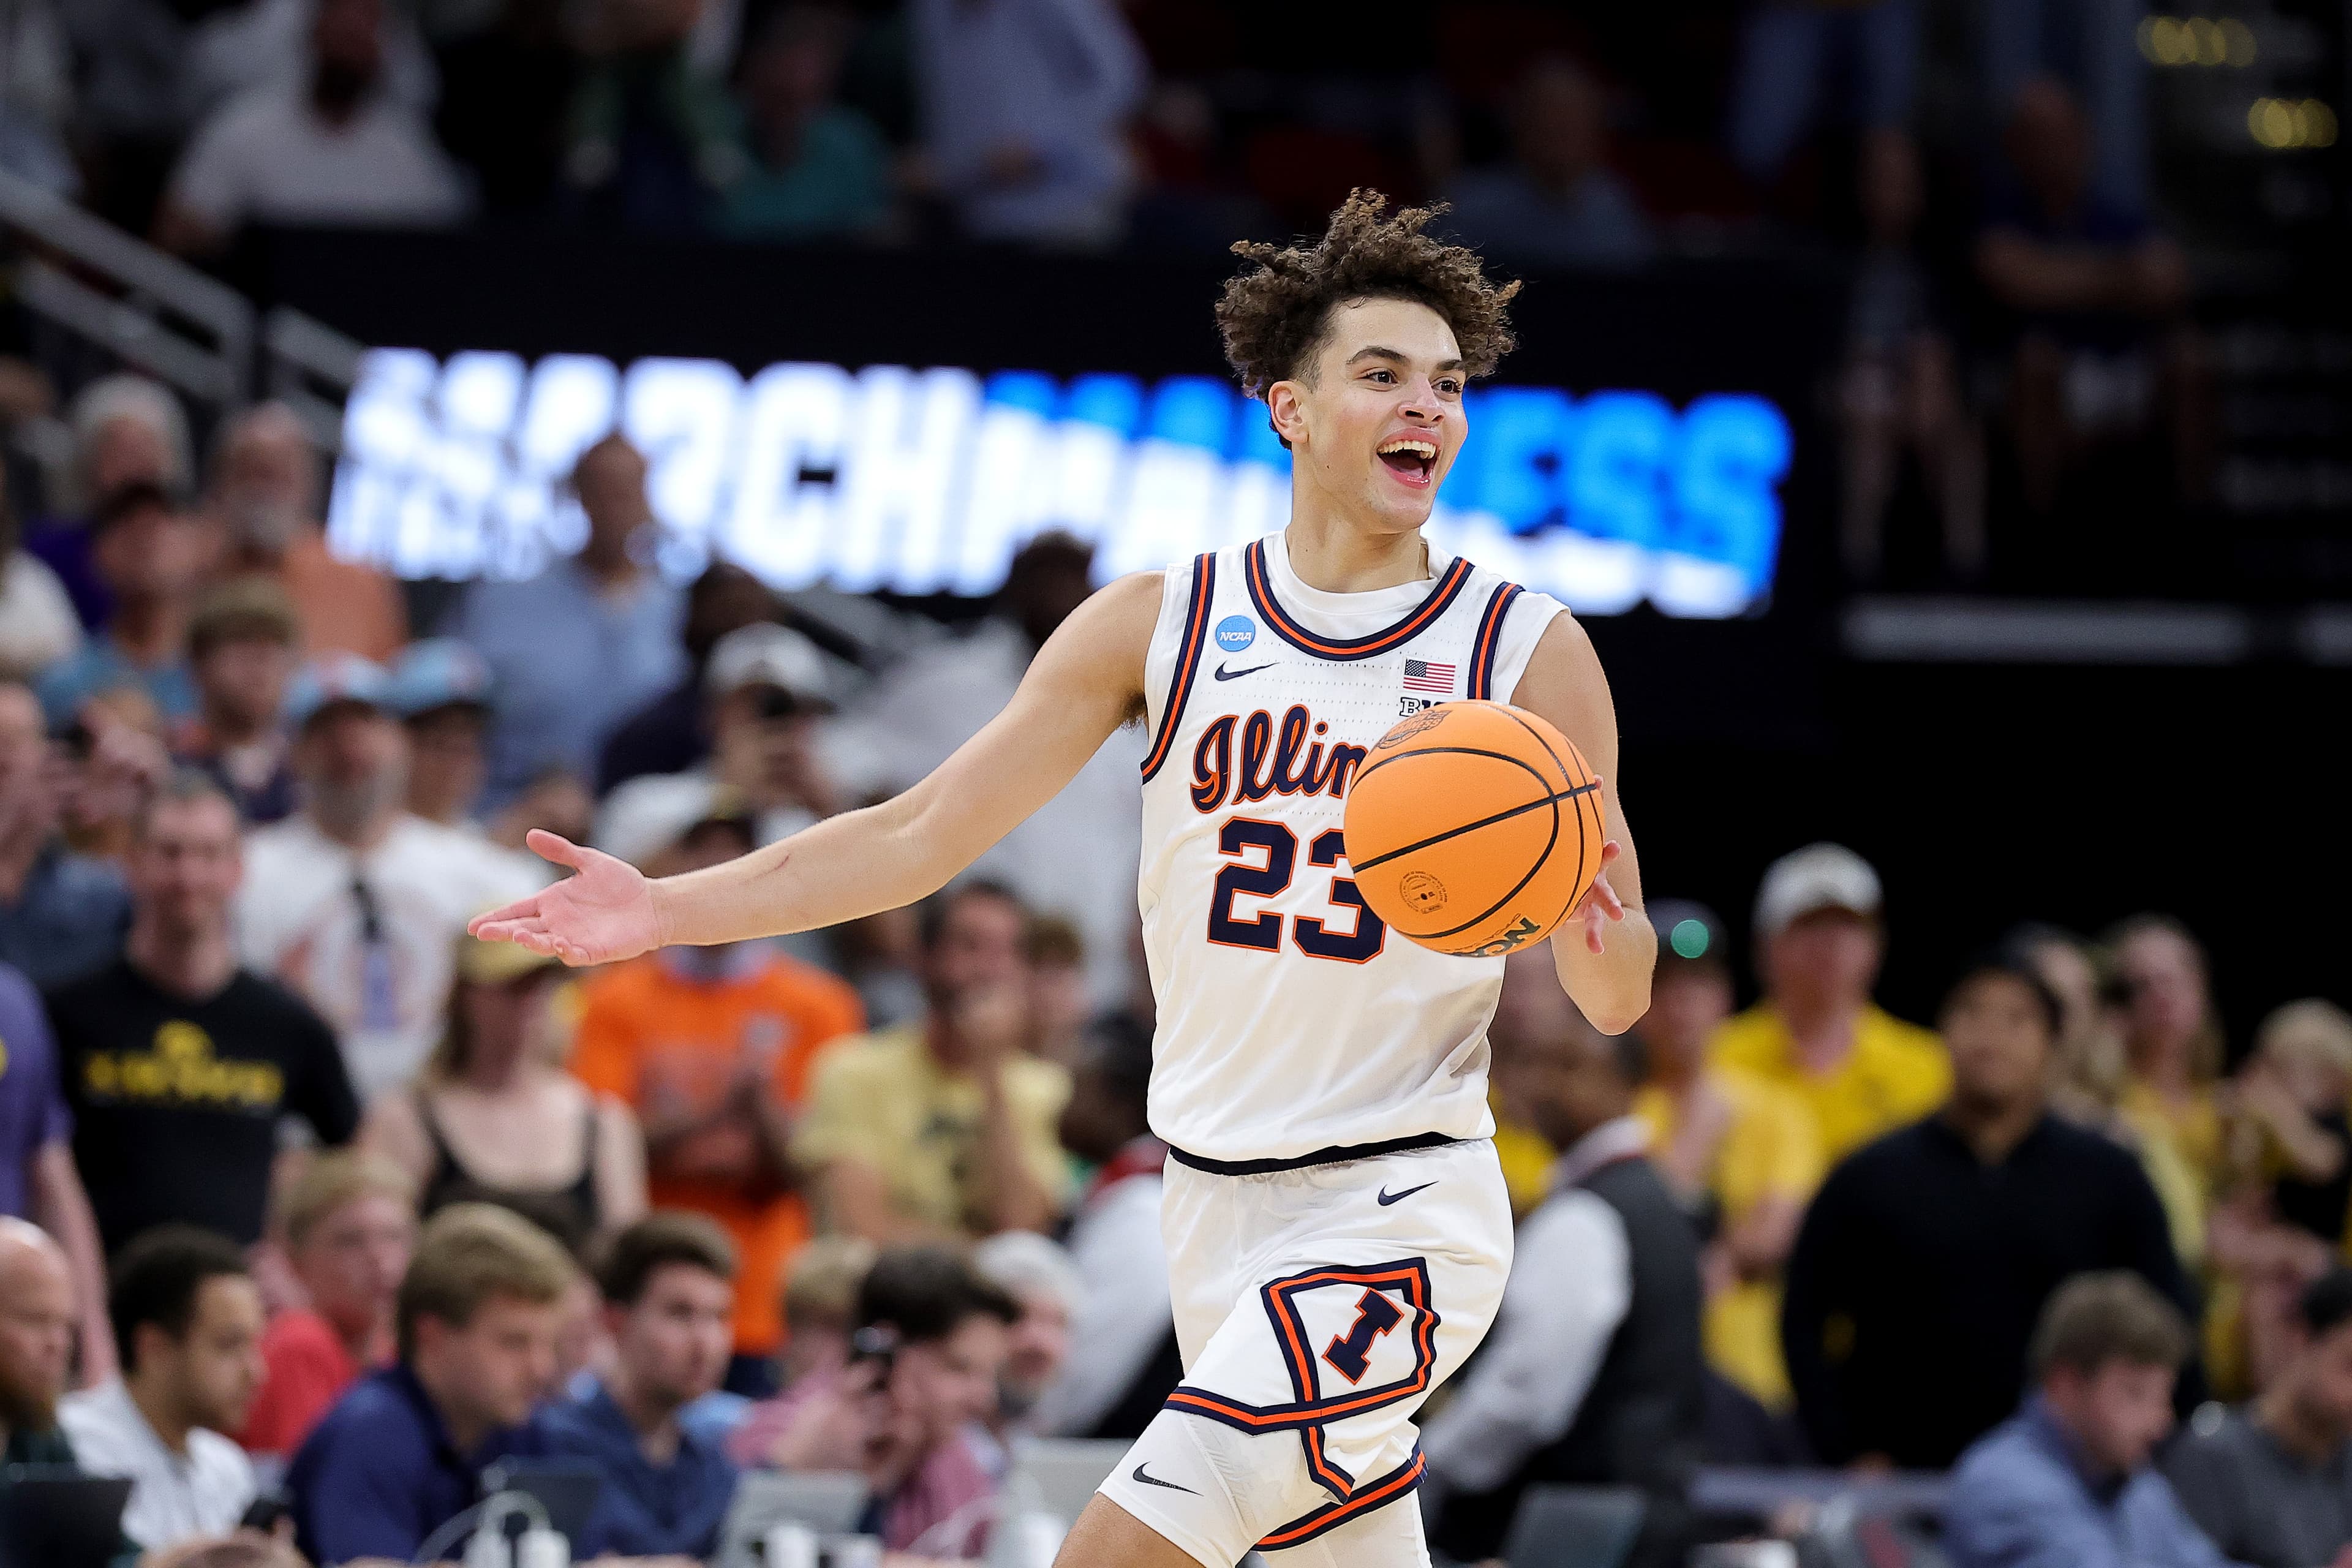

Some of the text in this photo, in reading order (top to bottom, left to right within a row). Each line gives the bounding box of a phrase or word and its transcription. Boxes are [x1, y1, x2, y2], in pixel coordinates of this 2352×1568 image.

[1219, 631, 1253, 642] NCAA
[1190, 704, 1369, 813] Illin
[1207, 816, 1387, 964] 23
